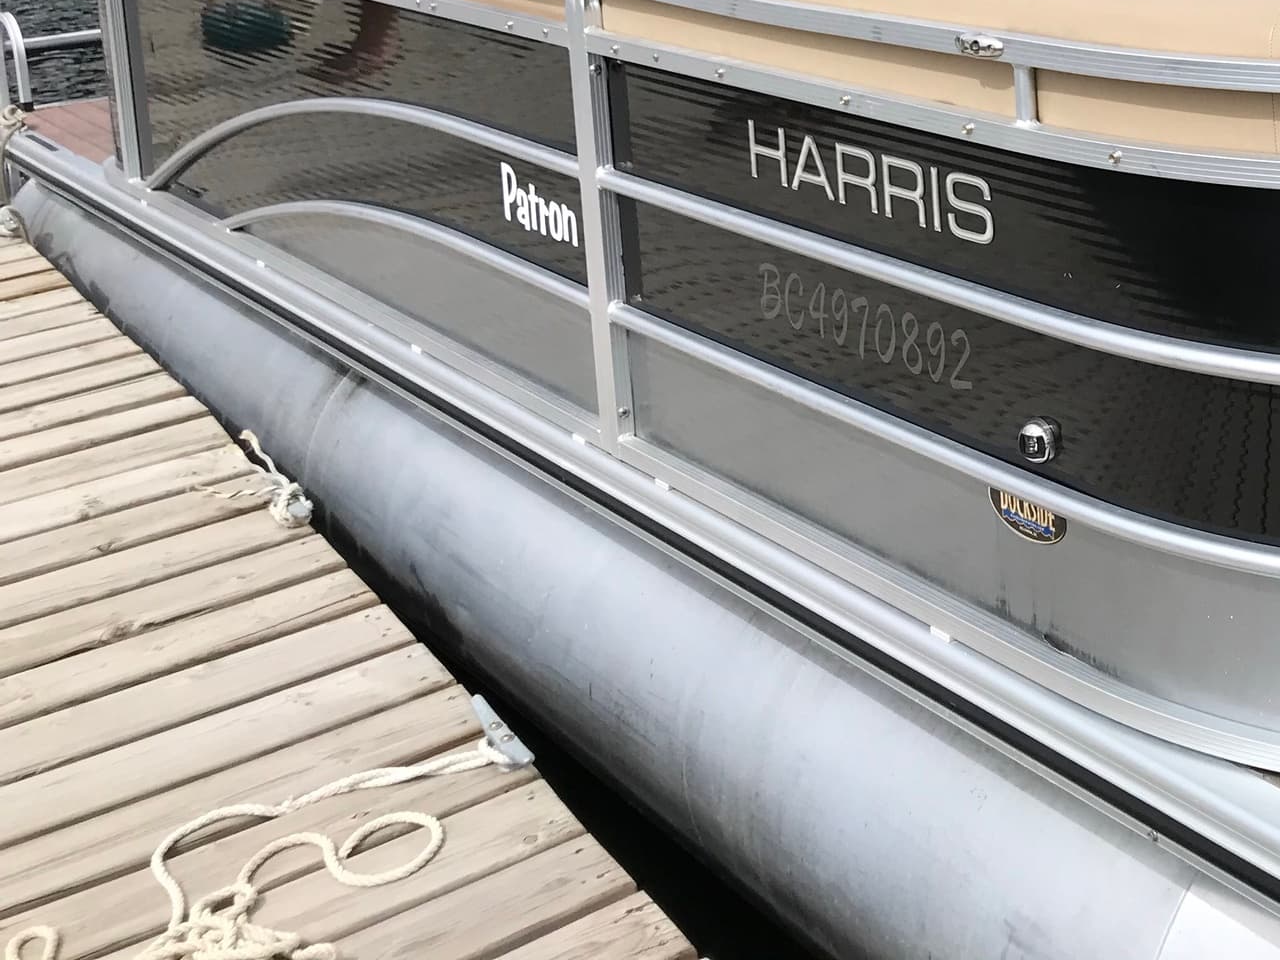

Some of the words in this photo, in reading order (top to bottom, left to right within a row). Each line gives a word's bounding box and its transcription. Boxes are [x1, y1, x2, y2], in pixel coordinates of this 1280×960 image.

[500, 161, 579, 248] Patron
[747, 119, 995, 245] HARRIS
[759, 262, 973, 390] BC4970892
